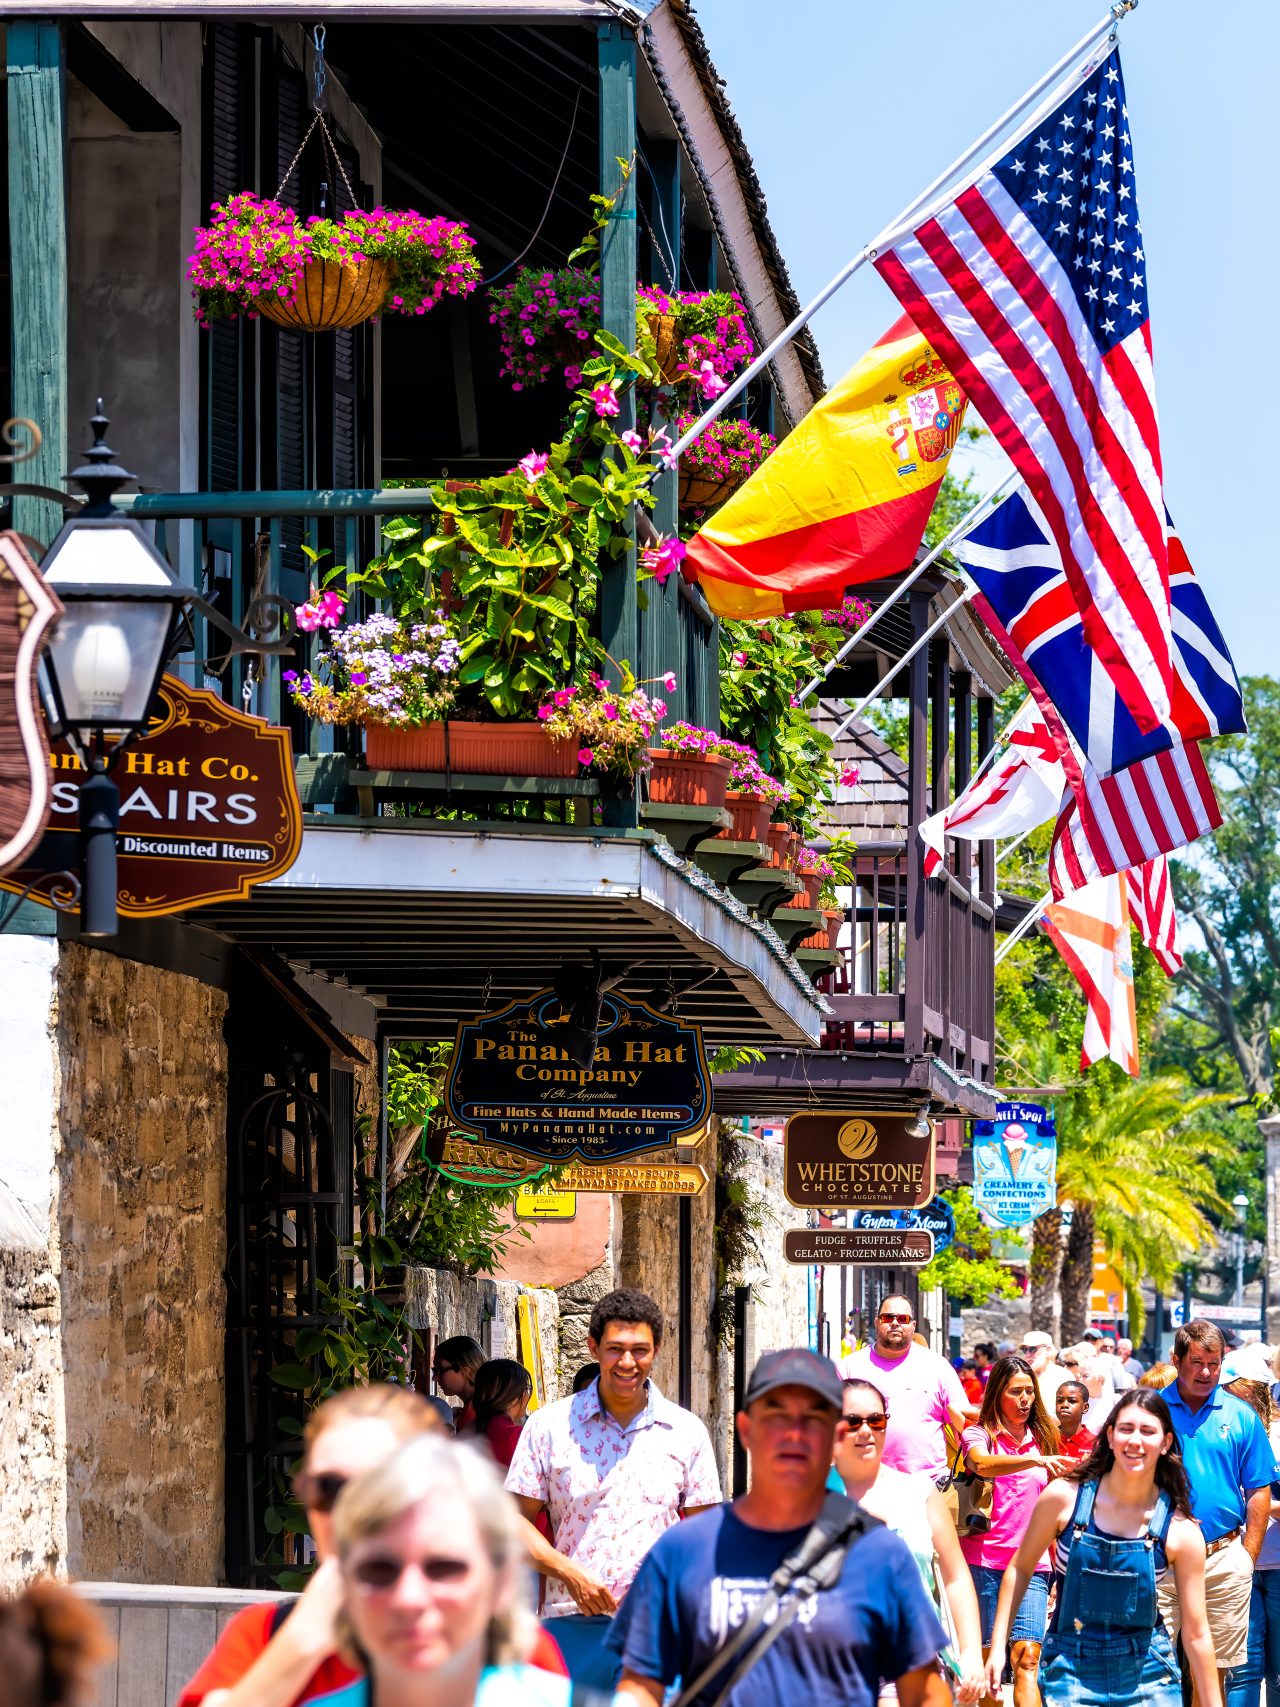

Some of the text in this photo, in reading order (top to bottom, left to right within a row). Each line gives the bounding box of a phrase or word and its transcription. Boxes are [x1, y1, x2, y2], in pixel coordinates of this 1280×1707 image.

[124, 752, 190, 777] Hat
[200, 756, 259, 782] Co.
[50, 782, 258, 825] SAIRS
[124, 837, 217, 858] Discounted
[222, 843, 270, 861] Items
[507, 1030, 538, 1042] The
[623, 1040, 688, 1064] Hat
[515, 1064, 643, 1087] Company
[473, 1106, 681, 1120] Fine Hats & Hand Made Items
[552, 1135, 578, 1144] Since
[570, 1166, 603, 1177] FRESH
[797, 1162, 923, 1183] WHETSTONE
[560, 1177, 619, 1189] MPANADAS
[623, 1179, 657, 1189] BAKED
[801, 1183, 923, 1193] CHOCOLATES
[983, 1181, 1033, 1189] CREAMERY
[983, 1190, 1046, 1198] CONFECTIONS
[998, 1201, 1030, 1209] ICE CREAM
[860, 1213, 948, 1230] Gypsy Moon
[815, 1235, 902, 1245] FUDGE TRUFFLES
[794, 1249, 925, 1258] GELATO FROZEN BANANAS
